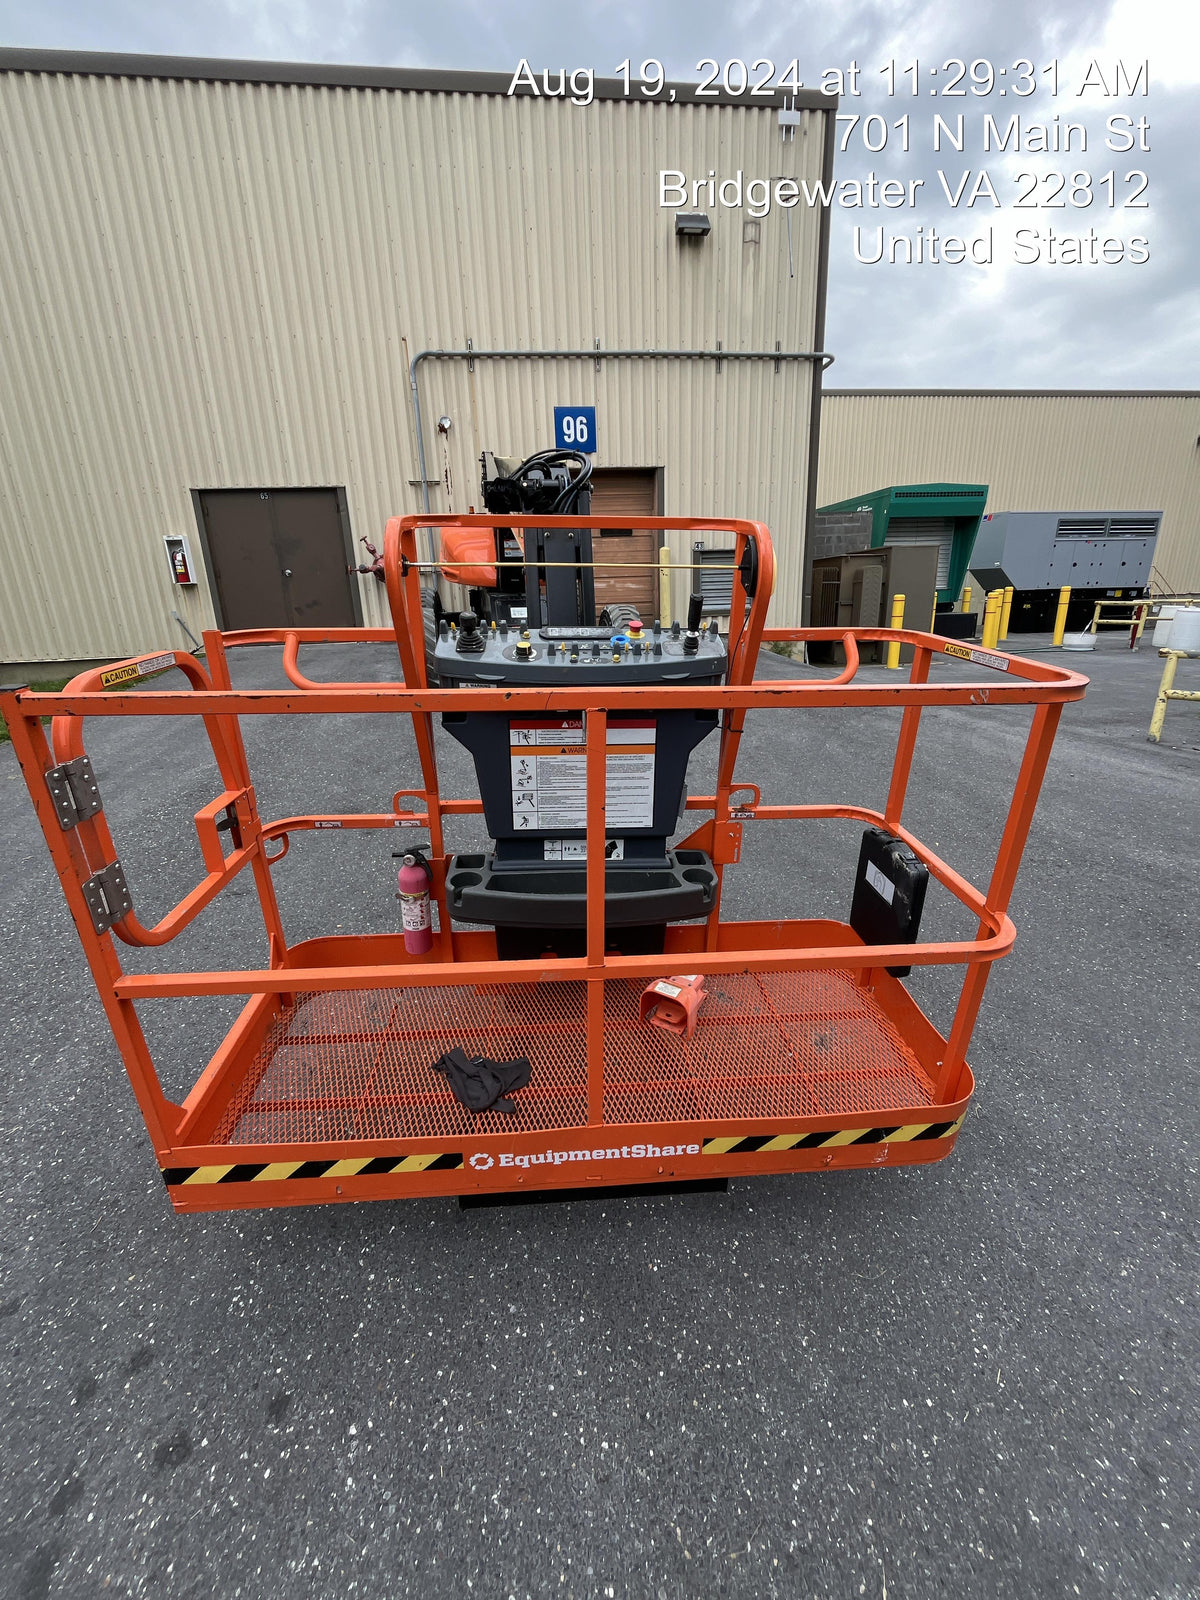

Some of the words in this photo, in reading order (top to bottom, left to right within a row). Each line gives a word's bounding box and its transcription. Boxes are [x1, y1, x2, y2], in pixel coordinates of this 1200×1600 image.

[562, 416, 588, 443] 96
[949, 645, 970, 658] CAUTION
[109, 666, 137, 682] CAUTION
[498, 1143, 700, 1168] EquipmentShare
